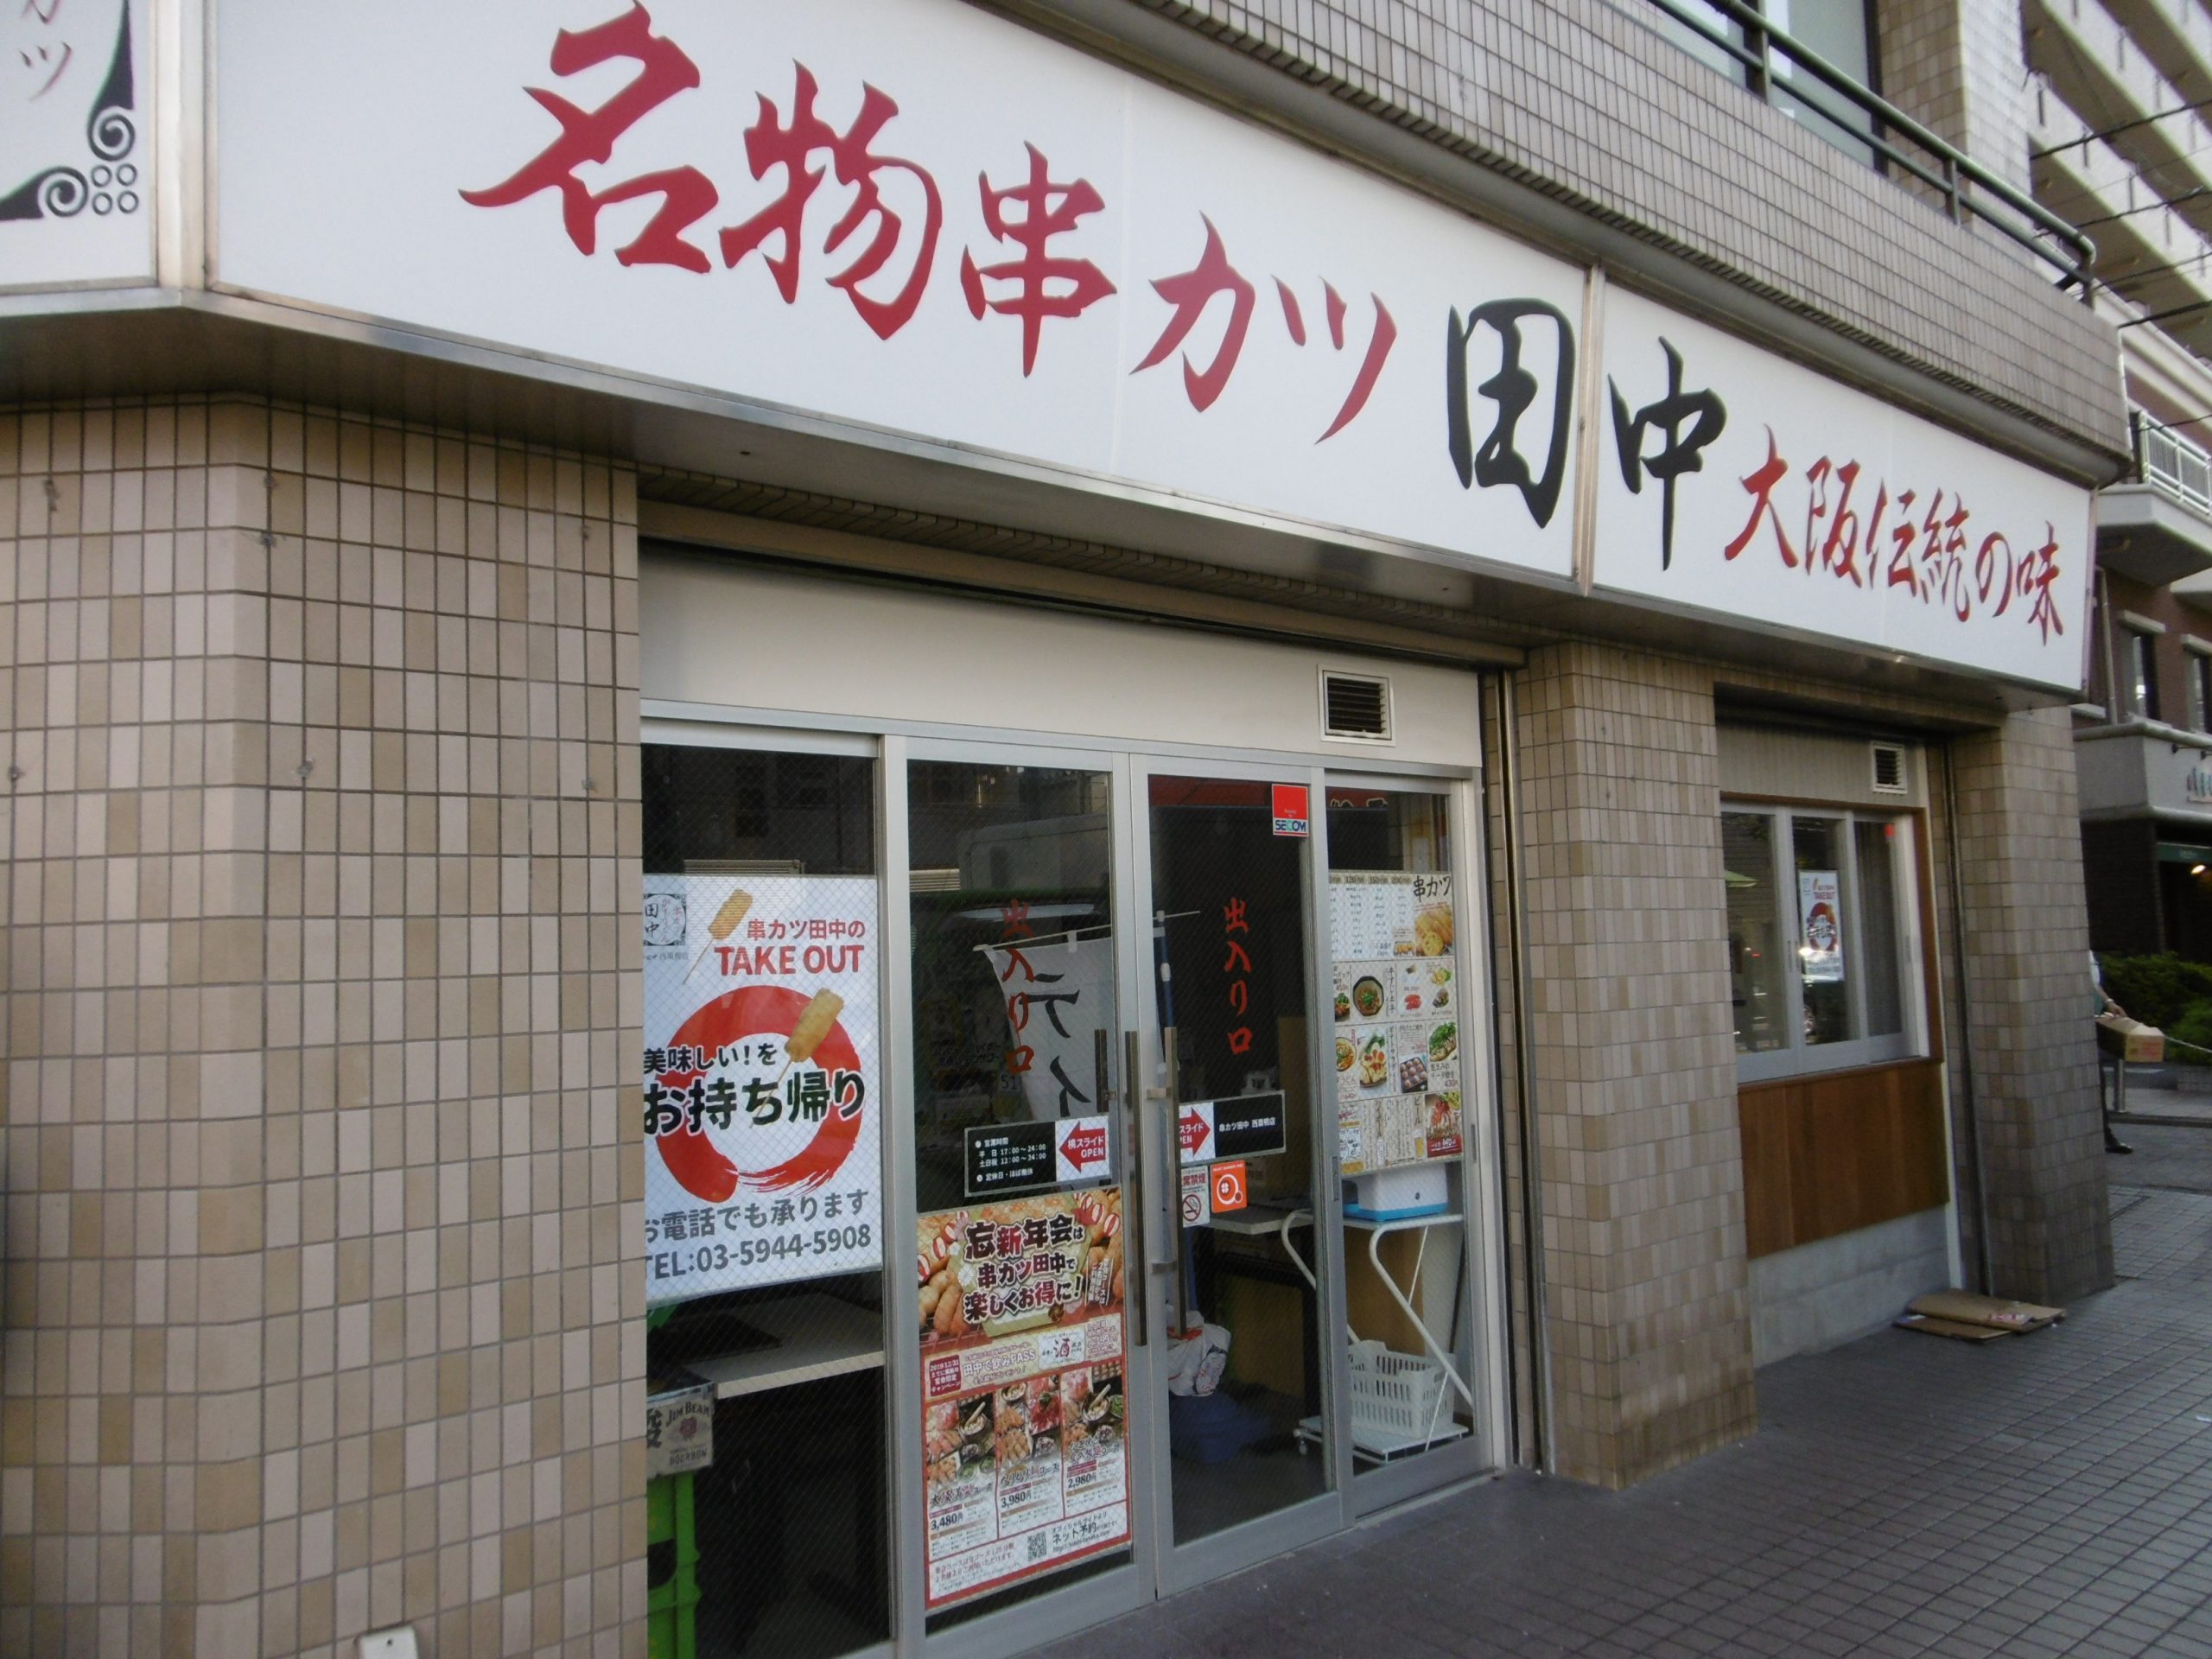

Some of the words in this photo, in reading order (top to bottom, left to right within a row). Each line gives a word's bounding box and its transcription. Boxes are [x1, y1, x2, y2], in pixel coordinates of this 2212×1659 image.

[1447, 296, 1728, 570] 田中
[1725, 424, 2063, 646] 大阪伝統の味
[1275, 819, 1306, 832] SECOM
[1414, 875, 1452, 903] 串カツ
[747, 918, 865, 940] 串カツ田中の
[715, 945, 797, 976] TAKE
[804, 944, 865, 974] OUT
[1223, 896, 1254, 1055] 出入り口
[1000, 898, 1035, 1074] 出入り口
[644, 1069, 865, 1135] お持ち帰り
[1068, 1135, 1104, 1150] 横スライド
[1081, 1147, 1104, 1158] OPEN
[1181, 1173, 1206, 1186] 席禁煙
[964, 1214, 1084, 1260] 忘新年会は
[978, 1253, 1075, 1288] 串カツ田中で
